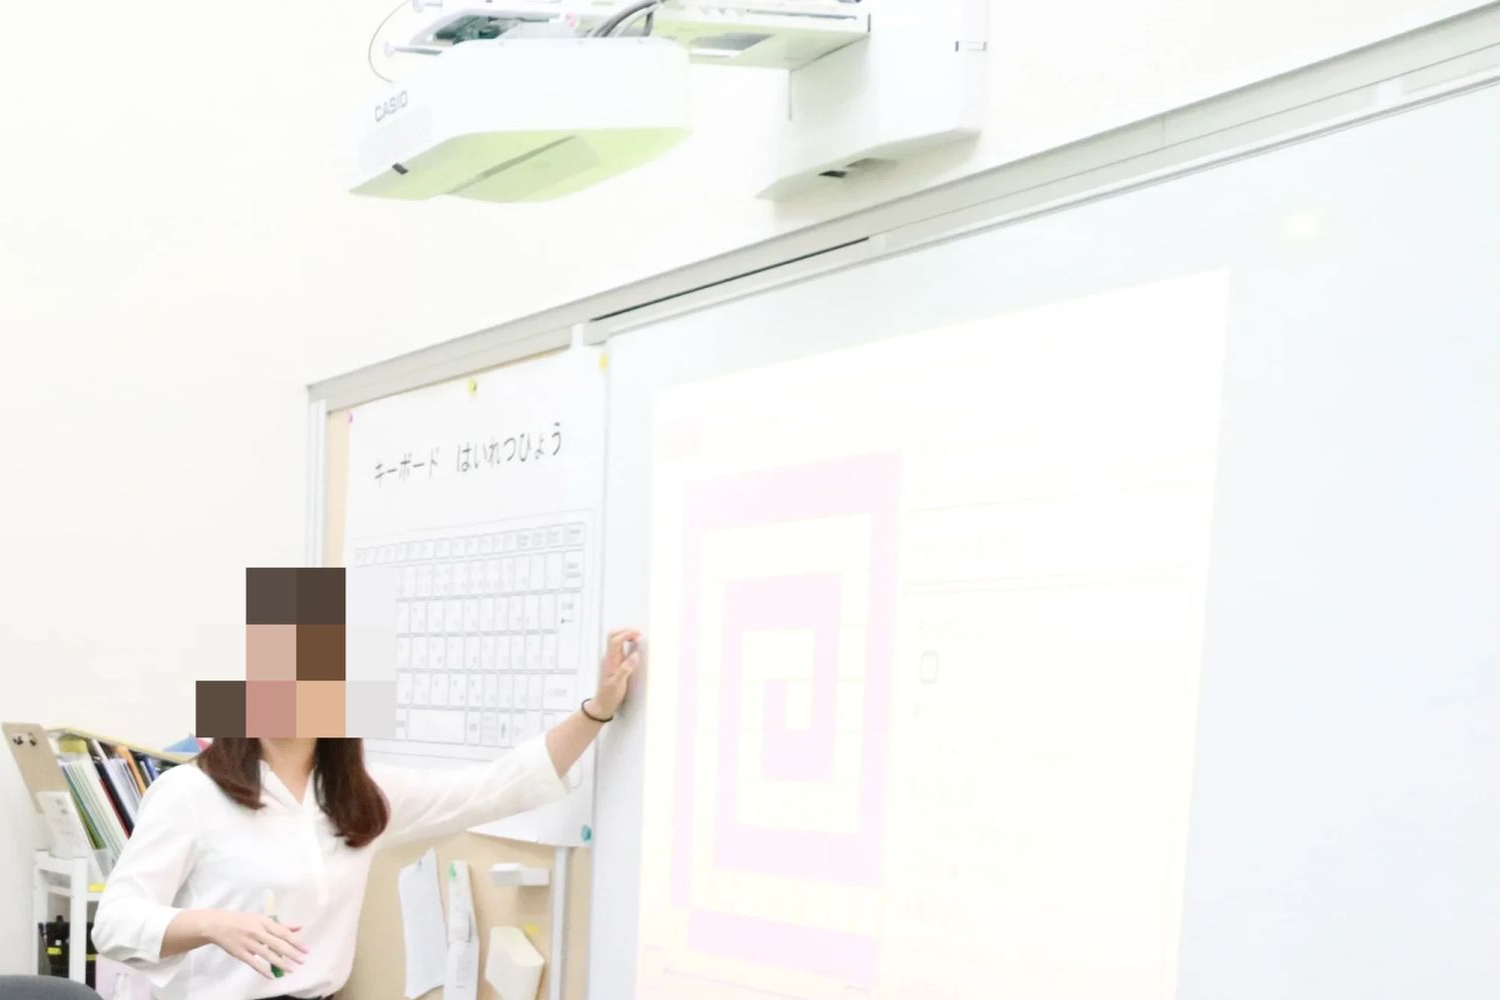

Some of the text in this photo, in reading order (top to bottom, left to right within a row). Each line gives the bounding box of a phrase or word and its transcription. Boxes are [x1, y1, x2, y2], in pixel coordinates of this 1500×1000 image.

[374, 90, 408, 122] CASIO
[374, 421, 562, 488] キーボード はいれつひょう
